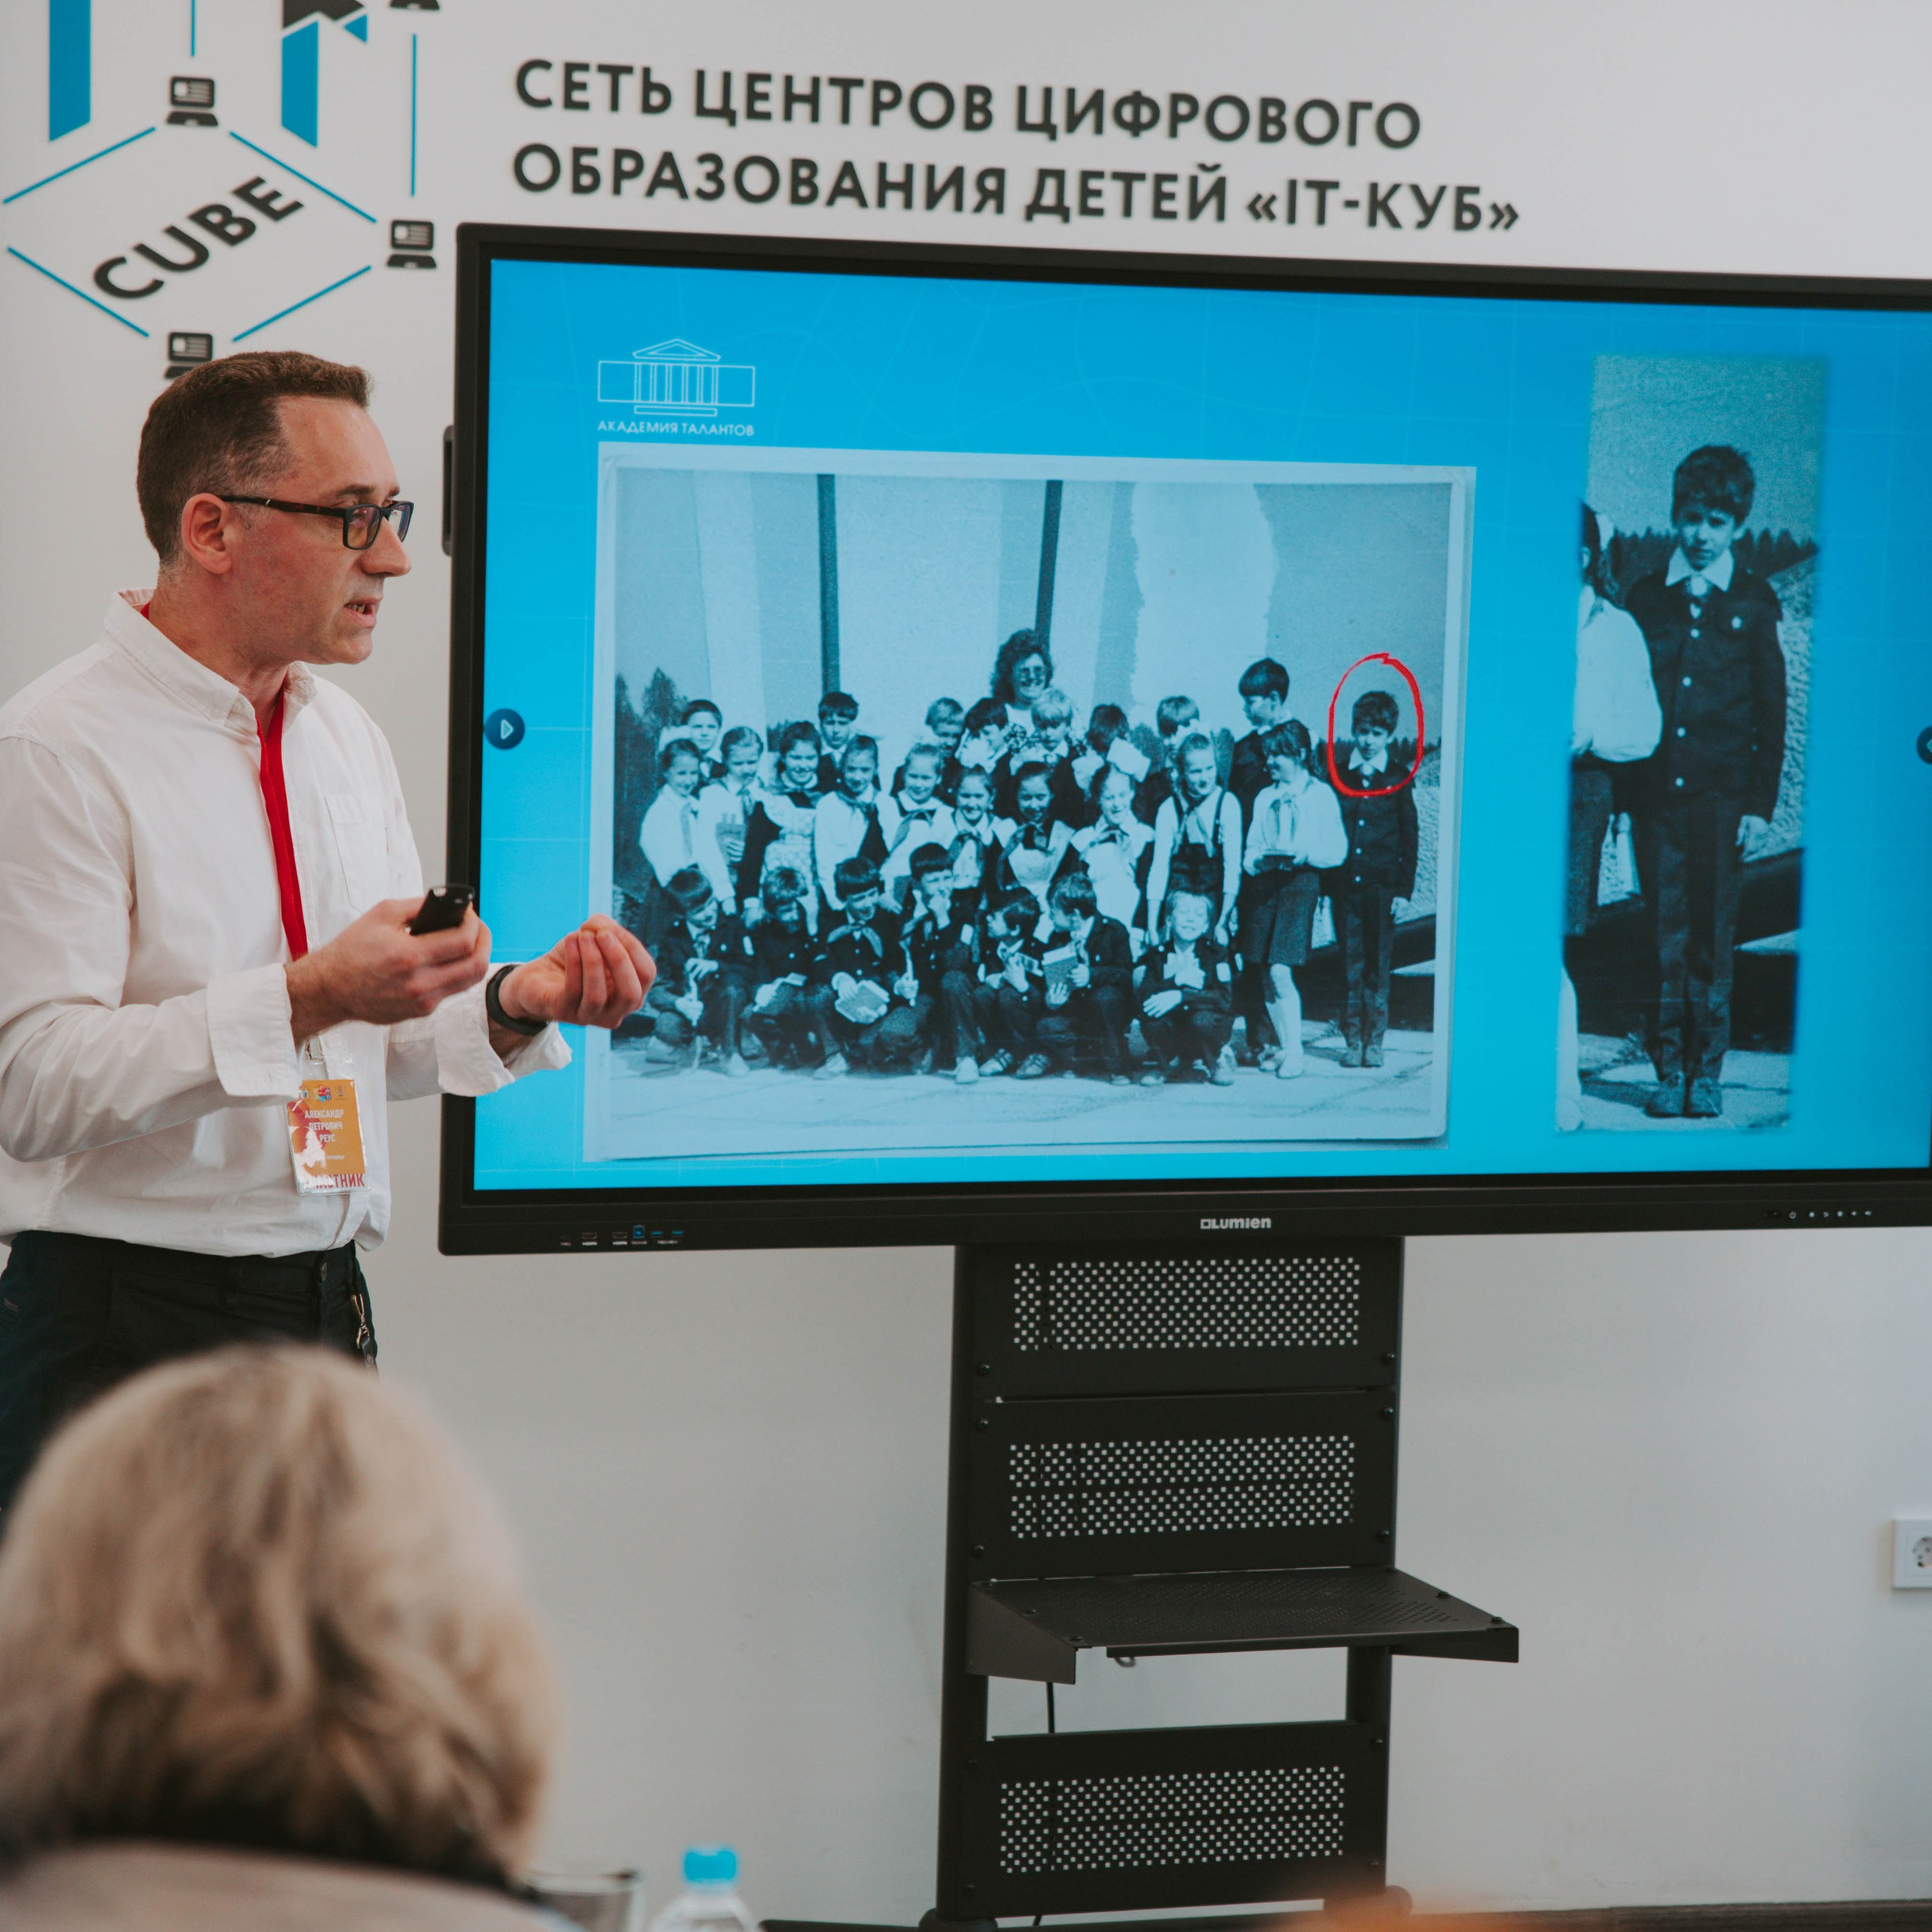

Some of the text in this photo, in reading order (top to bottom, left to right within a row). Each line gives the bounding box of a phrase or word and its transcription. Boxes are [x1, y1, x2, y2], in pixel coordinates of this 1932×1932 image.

[516, 60, 1421, 149] СЕТЬ ЦЕНТРОВ ЦИФРОВОГО
[514, 143, 1005, 214] ОБРАЗОВАНИЯ
[1025, 163, 1227, 223] ДЕТЕЙ
[94, 176, 303, 300] CUBE
[598, 420, 754, 436] АКАДЕМИЯ ТАЛАНТОВ
[305, 1109, 344, 1119] АЛЕКСАНДР
[309, 1121, 343, 1131] ПЕТРОВИЧ
[319, 1134, 336, 1143] РЕУС
